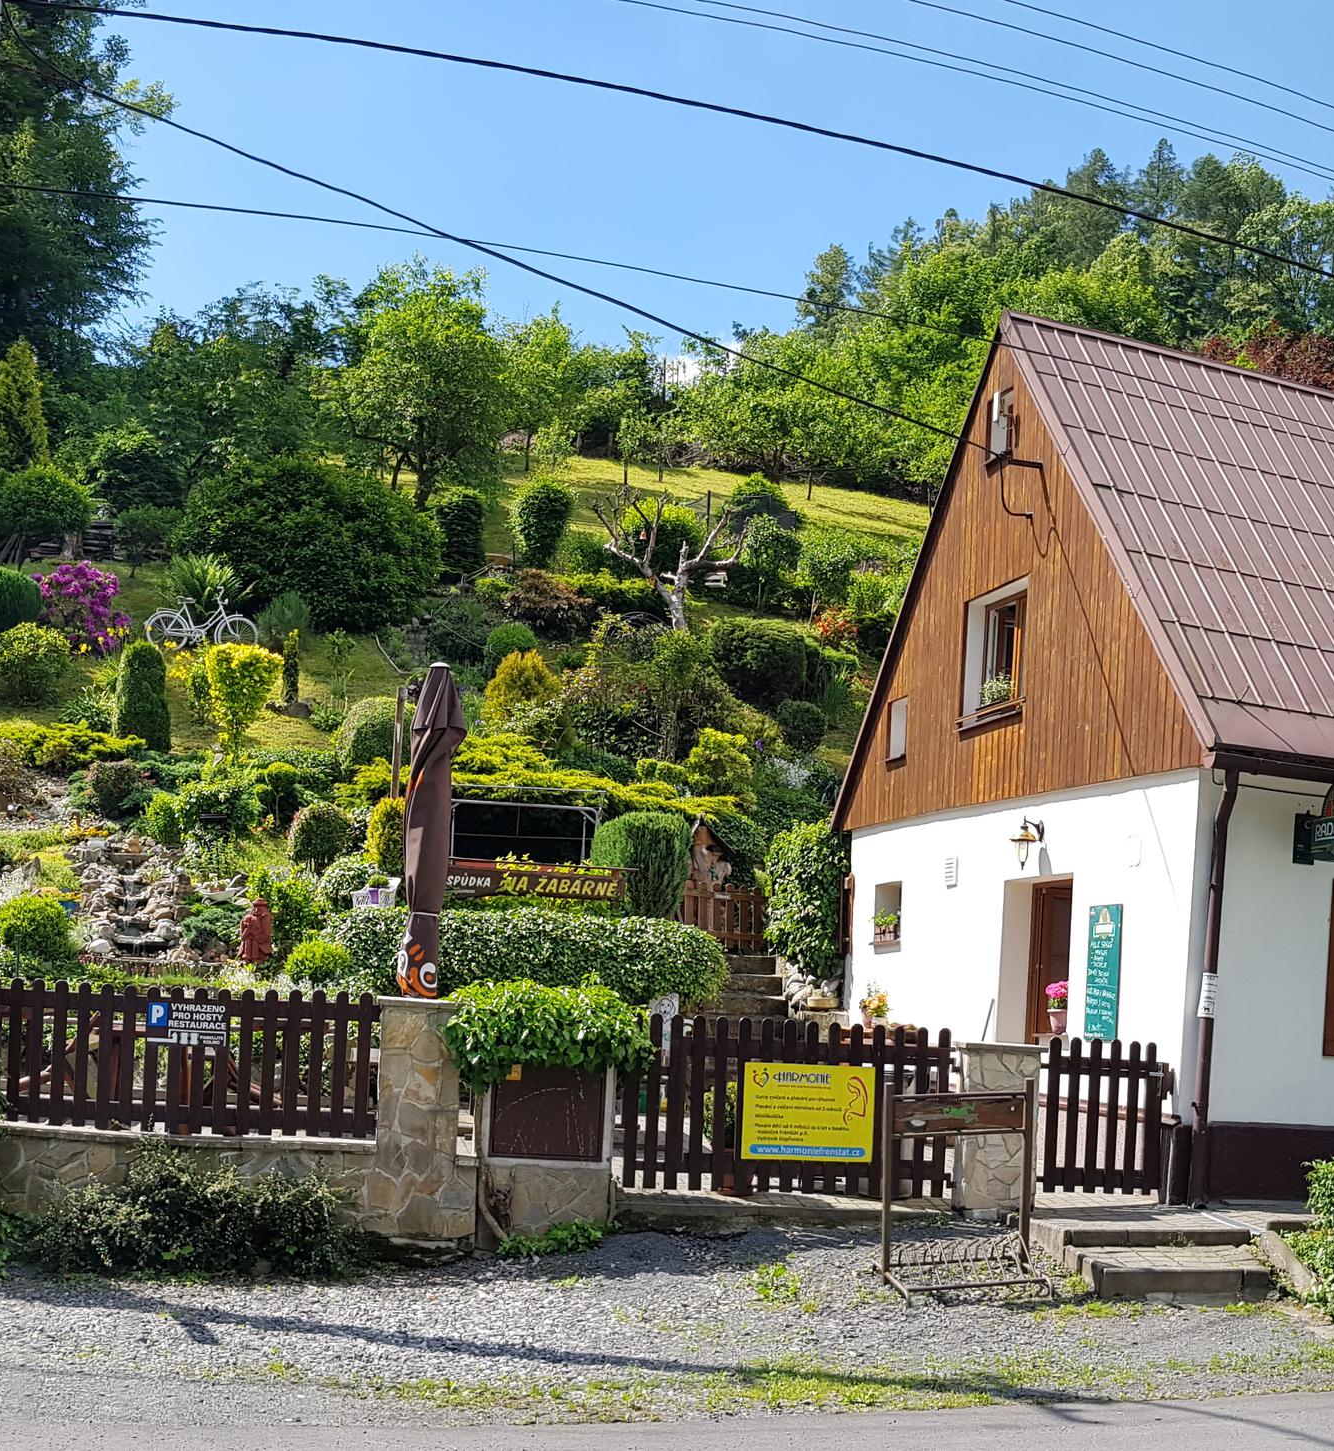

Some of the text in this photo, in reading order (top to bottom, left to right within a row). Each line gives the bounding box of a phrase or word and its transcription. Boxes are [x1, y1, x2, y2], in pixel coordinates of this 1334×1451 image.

[446, 872, 491, 888] SPŮDKA
[151, 1004, 164, 1024] P
[171, 1003, 226, 1013] VYHRAZENO
[172, 1011, 224, 1022] PRO HOSTY
[168, 1019, 227, 1030] RESTAURACE
[773, 1071, 833, 1085] HARMONIE
